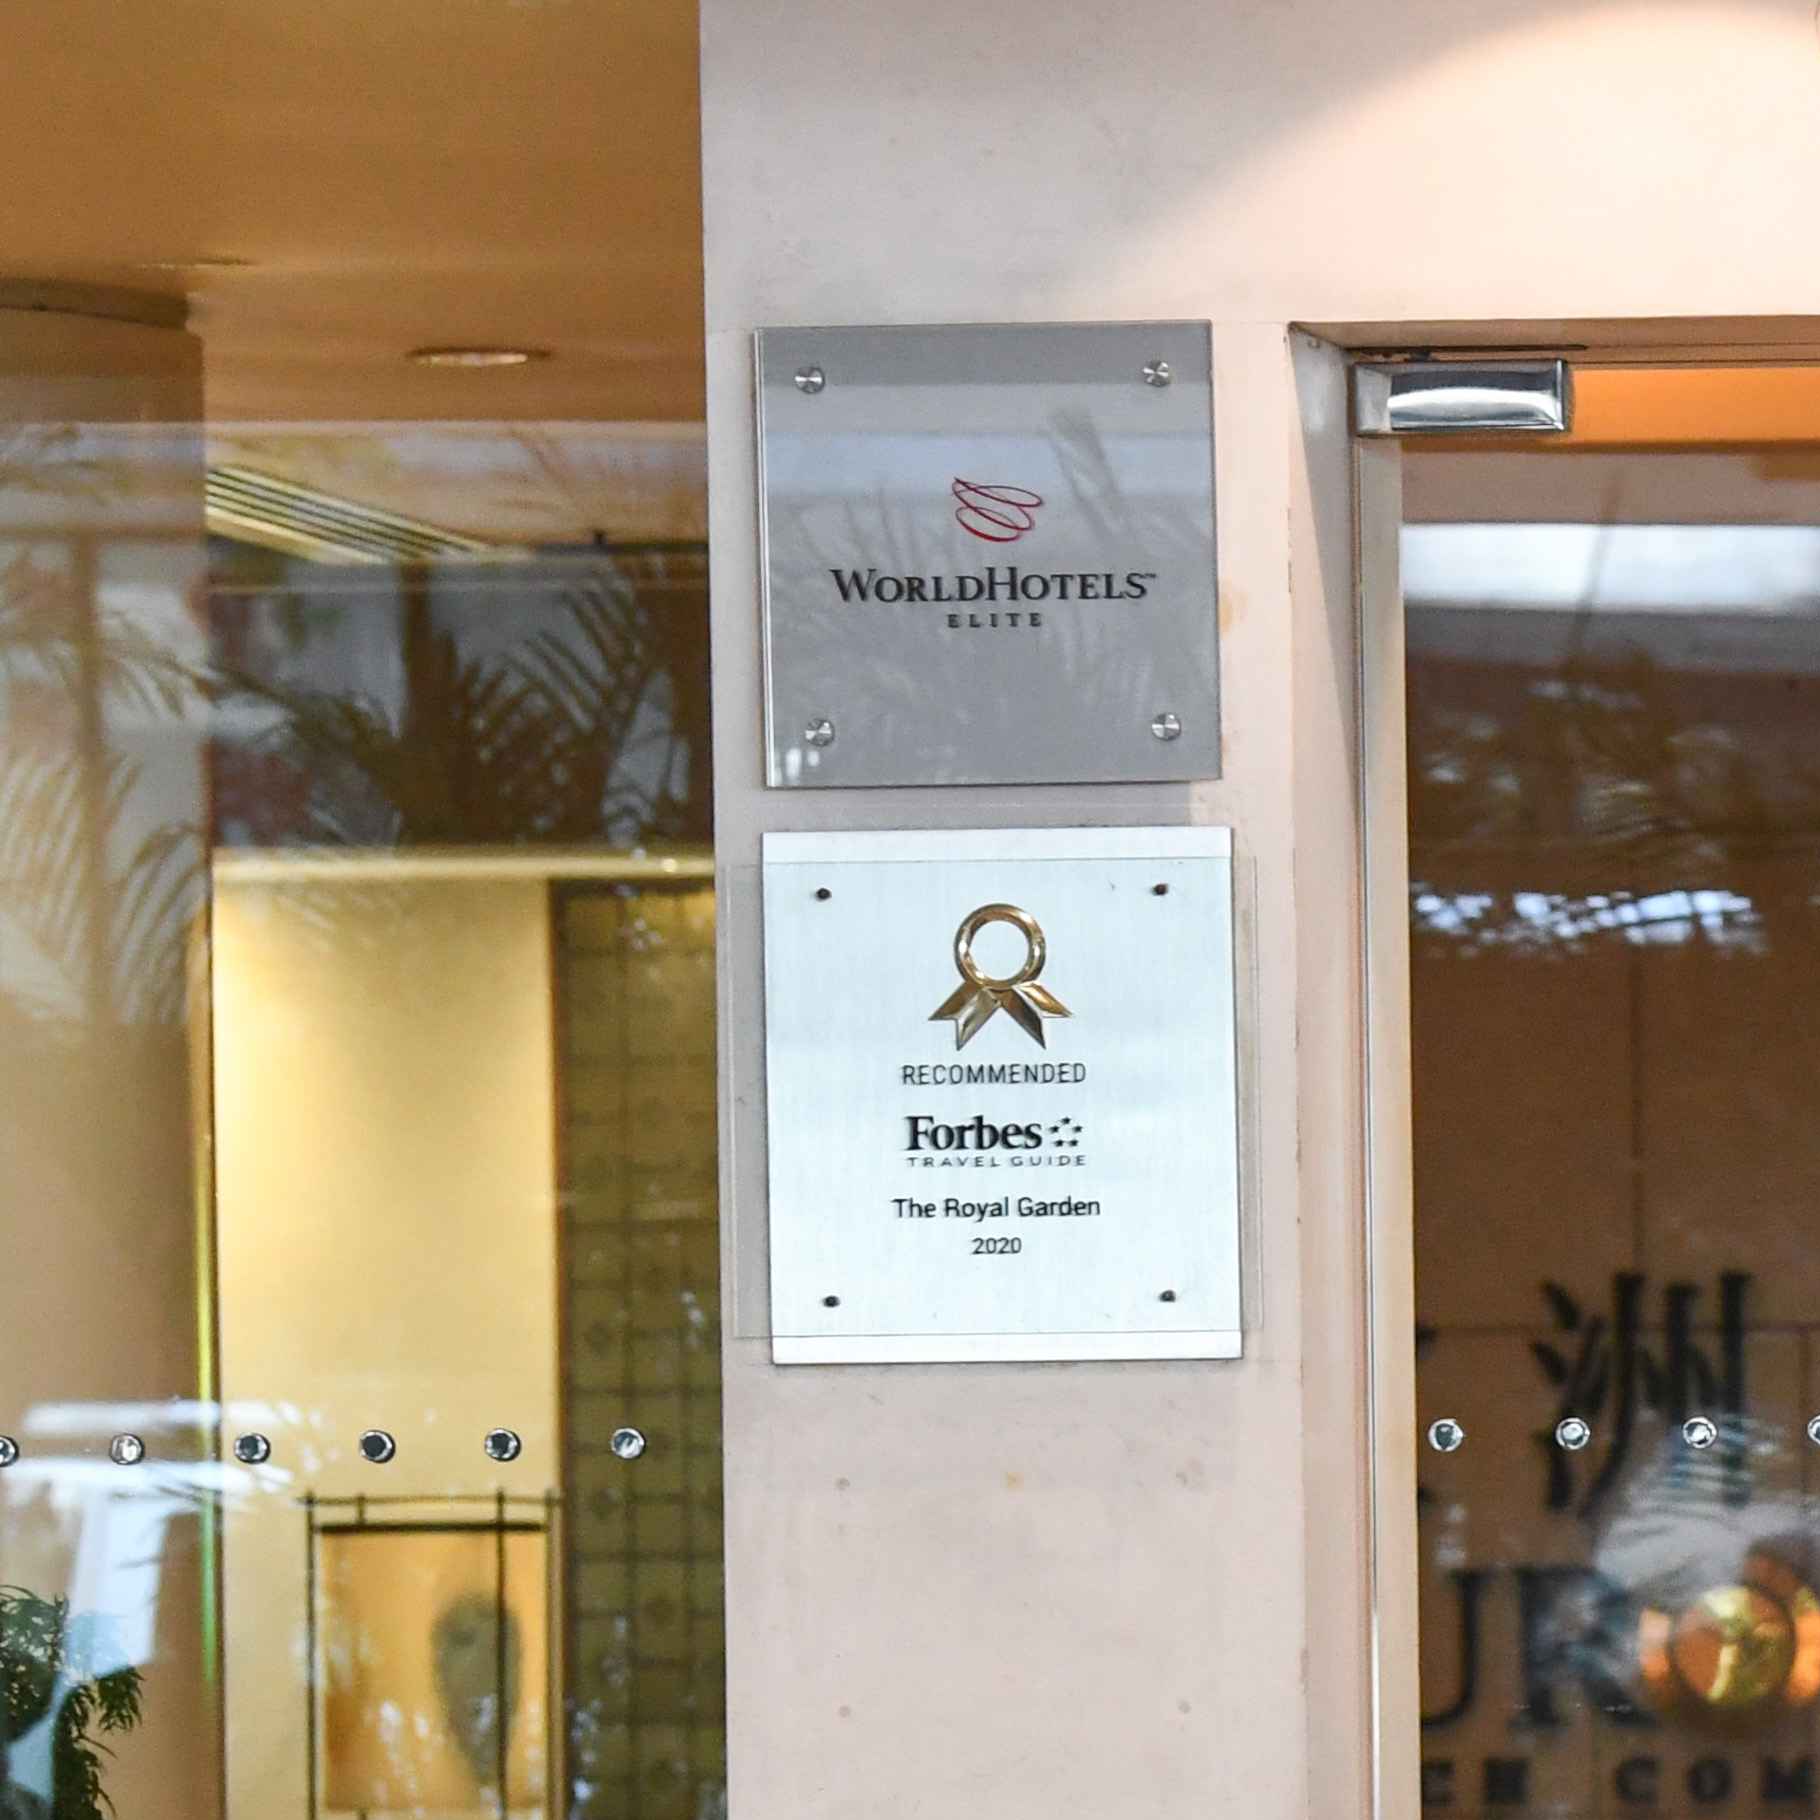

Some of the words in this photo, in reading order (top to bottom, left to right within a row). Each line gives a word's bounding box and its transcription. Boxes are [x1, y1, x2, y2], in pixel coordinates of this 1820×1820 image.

[946, 611, 1043, 629] ELITE
[901, 1063, 1087, 1085] RECOMMENDED
[904, 1115, 1043, 1151] Forbes
[907, 1156, 1001, 1168] TRAVEL
[1010, 1154, 1087, 1167] GUIDE
[891, 1198, 936, 1218] The
[943, 1196, 1010, 1222] Royal
[1017, 1196, 1101, 1217] Garden
[970, 1237, 1022, 1255] 2020
